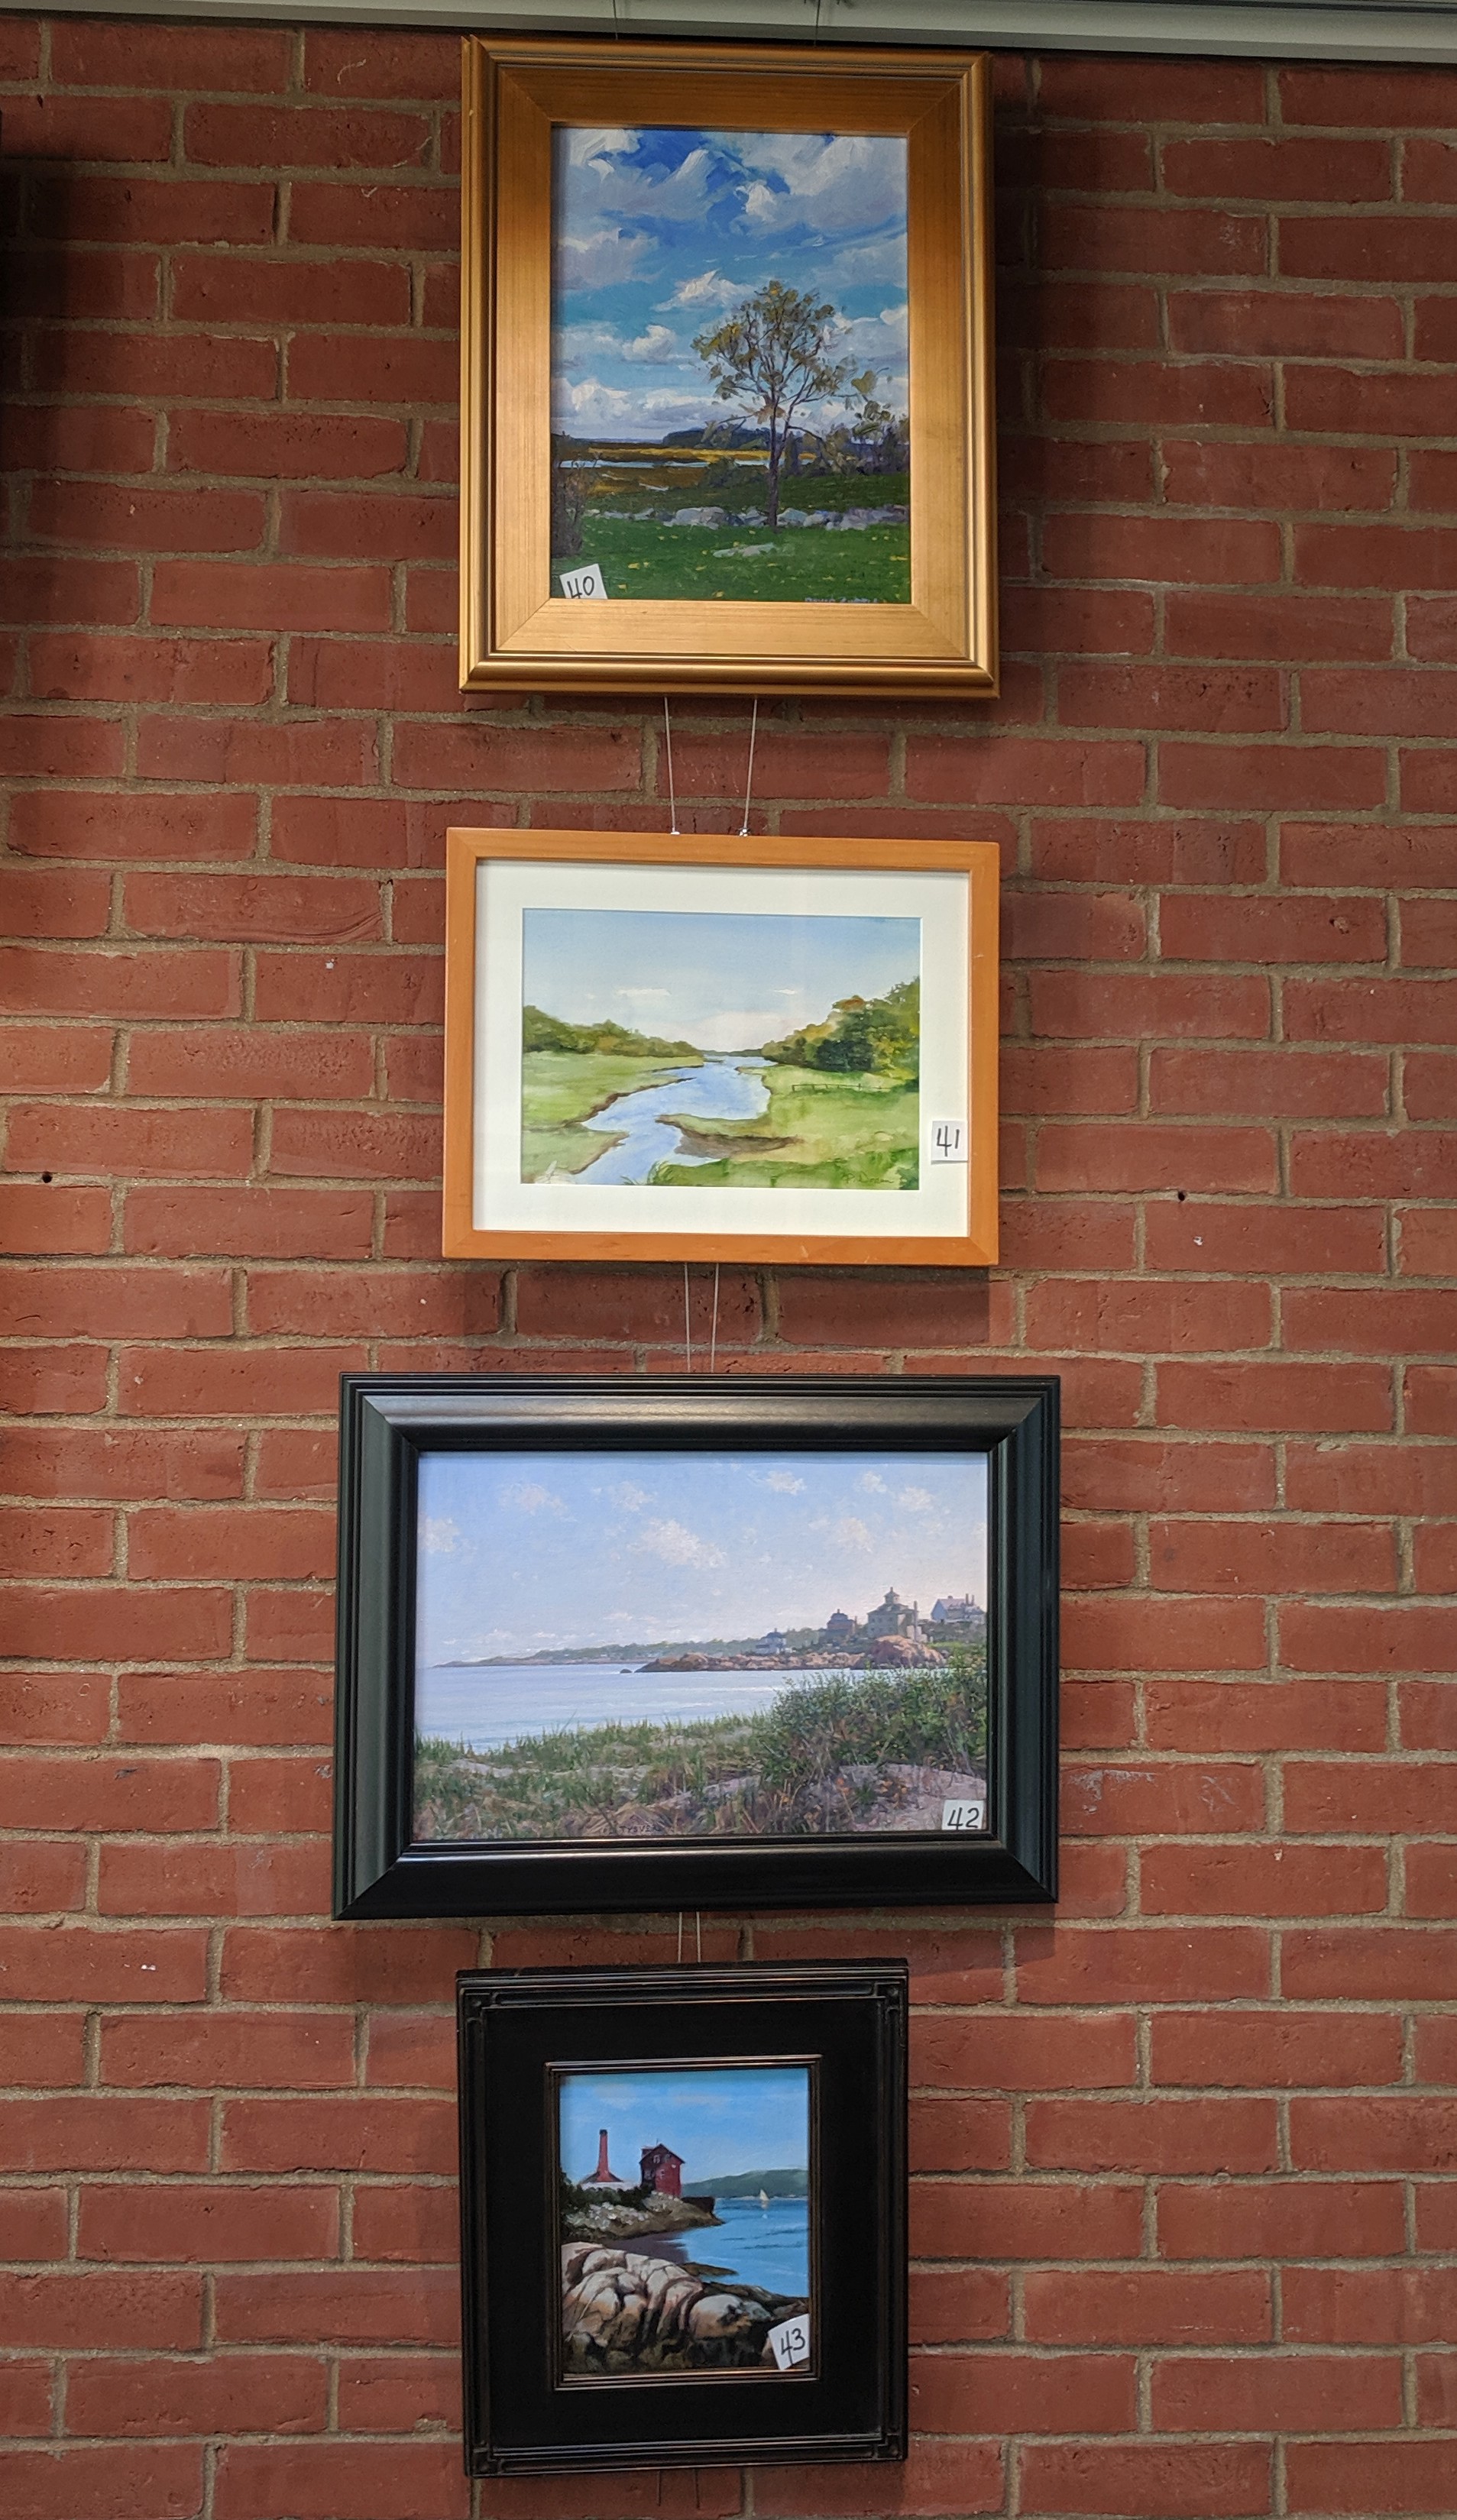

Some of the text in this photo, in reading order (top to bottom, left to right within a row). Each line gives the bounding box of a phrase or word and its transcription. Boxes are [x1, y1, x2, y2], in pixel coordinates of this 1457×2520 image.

[567, 575, 595, 599] 40
[937, 1125, 960, 1157] 41
[947, 1807, 979, 1830] 42
[781, 2328, 806, 2366] 43
